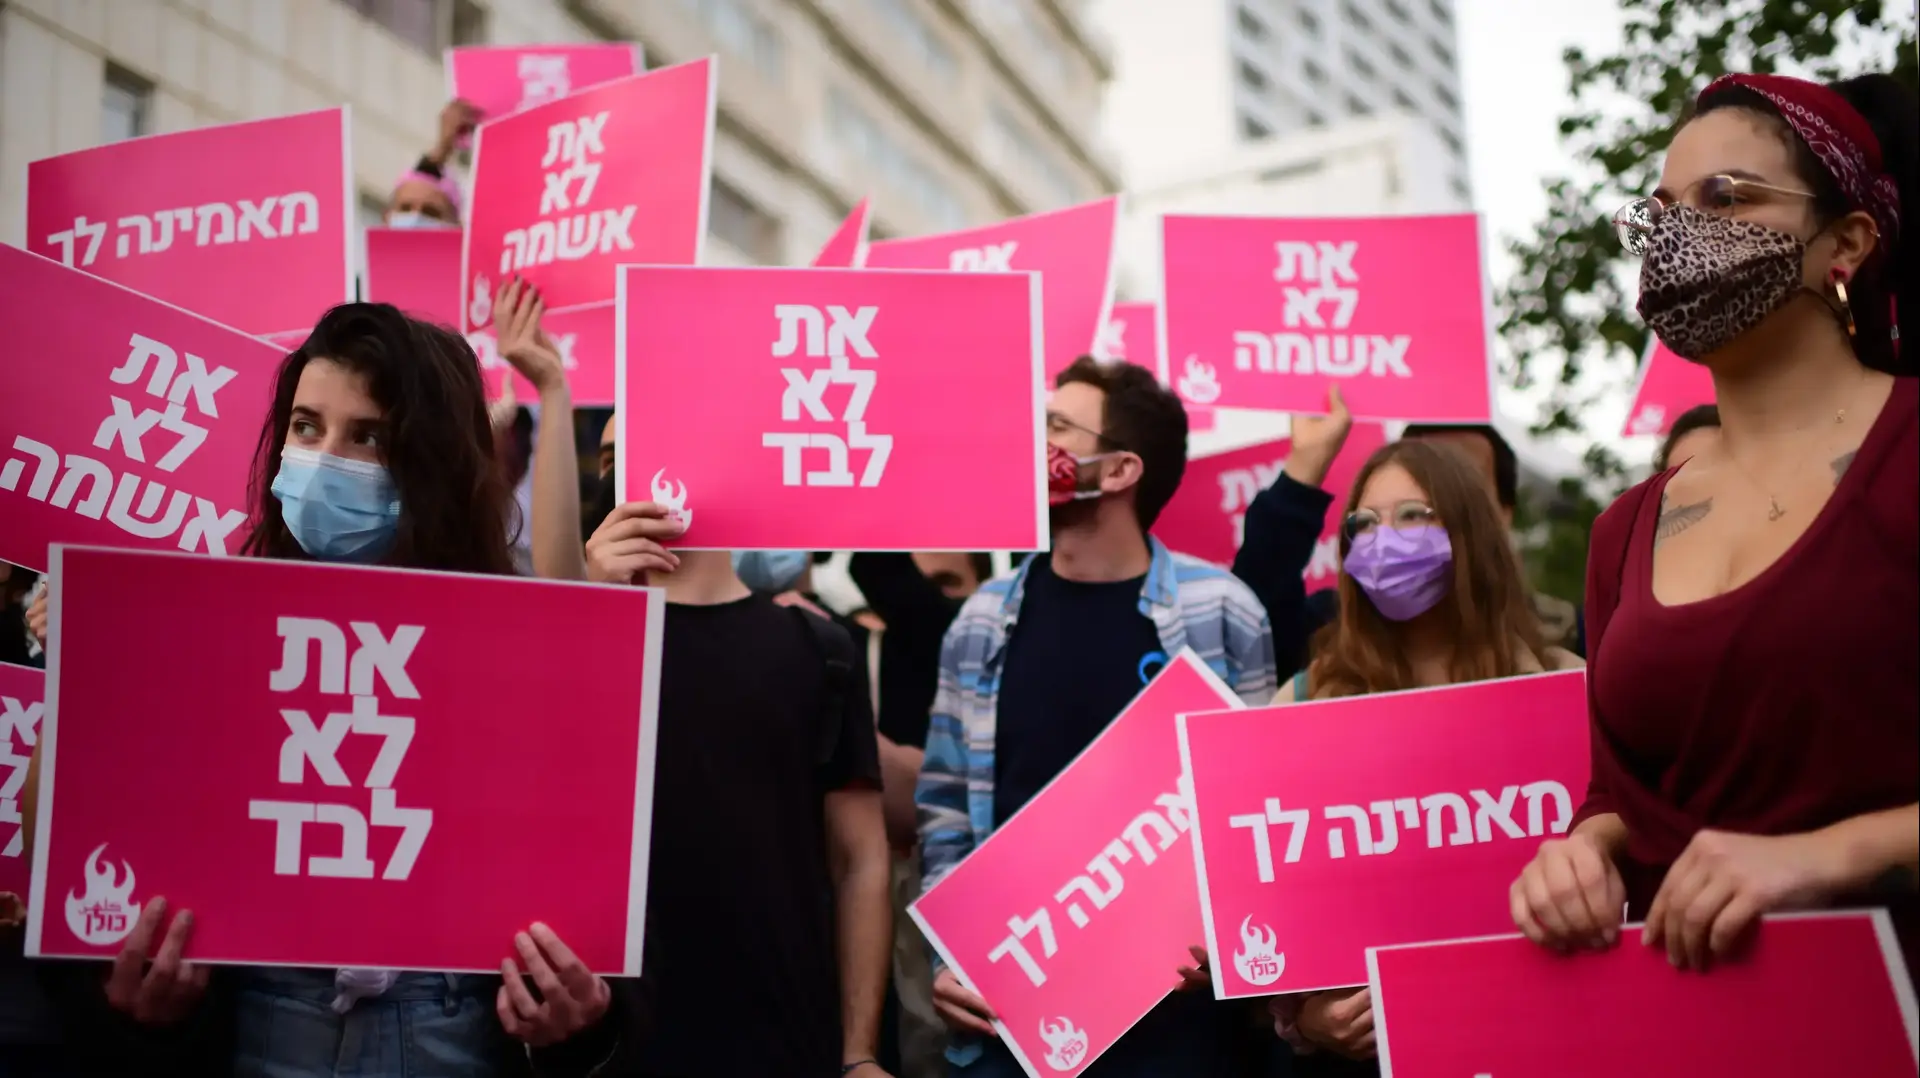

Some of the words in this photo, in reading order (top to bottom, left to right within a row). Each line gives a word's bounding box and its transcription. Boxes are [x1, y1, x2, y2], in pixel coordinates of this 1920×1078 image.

[542, 110, 608, 168] את
[540, 150, 602, 215] לא
[48, 215, 106, 268] לך
[116, 191, 319, 258] מאמינה
[501, 204, 638, 275] אשמה
[1273, 241, 1358, 282] את
[771, 304, 880, 358] את
[1282, 278, 1358, 329] לא
[109, 333, 238, 419] את
[779, 355, 877, 422] לא
[1233, 331, 1412, 377] אשמה
[93, 395, 208, 473] לא
[762, 420, 893, 487] לבד
[0, 435, 249, 557] אשמה
[269, 616, 425, 699] את
[279, 695, 415, 787] לא
[249, 787, 433, 880] לבד
[1229, 798, 1310, 883] לך
[1324, 780, 1573, 858] מאמינה
[988, 906, 1058, 987] לך
